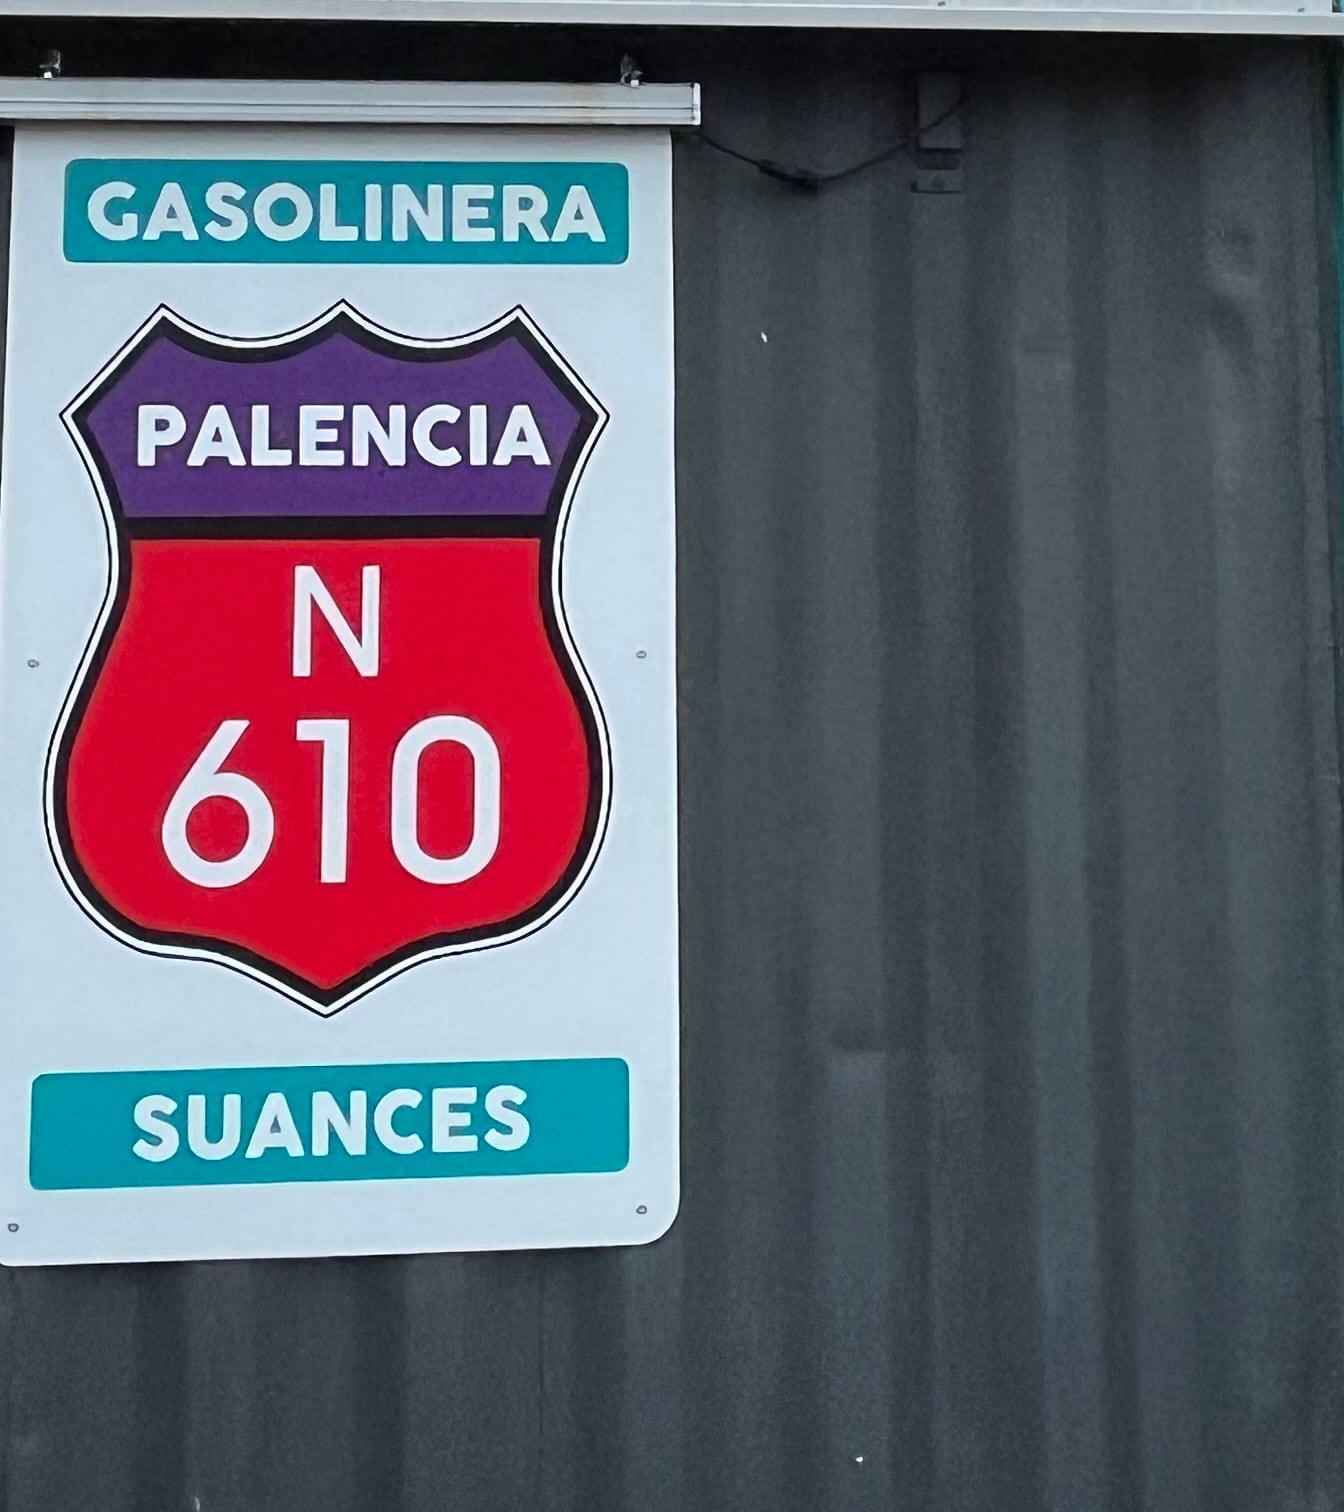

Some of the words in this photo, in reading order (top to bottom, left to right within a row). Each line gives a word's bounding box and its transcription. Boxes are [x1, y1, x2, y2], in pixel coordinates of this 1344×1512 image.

[86, 181, 607, 243] GASOLINERA
[136, 404, 551, 467] PALENCIA
[292, 564, 381, 678] N
[161, 715, 501, 889] 610
[131, 1084, 531, 1163] SUANCES
